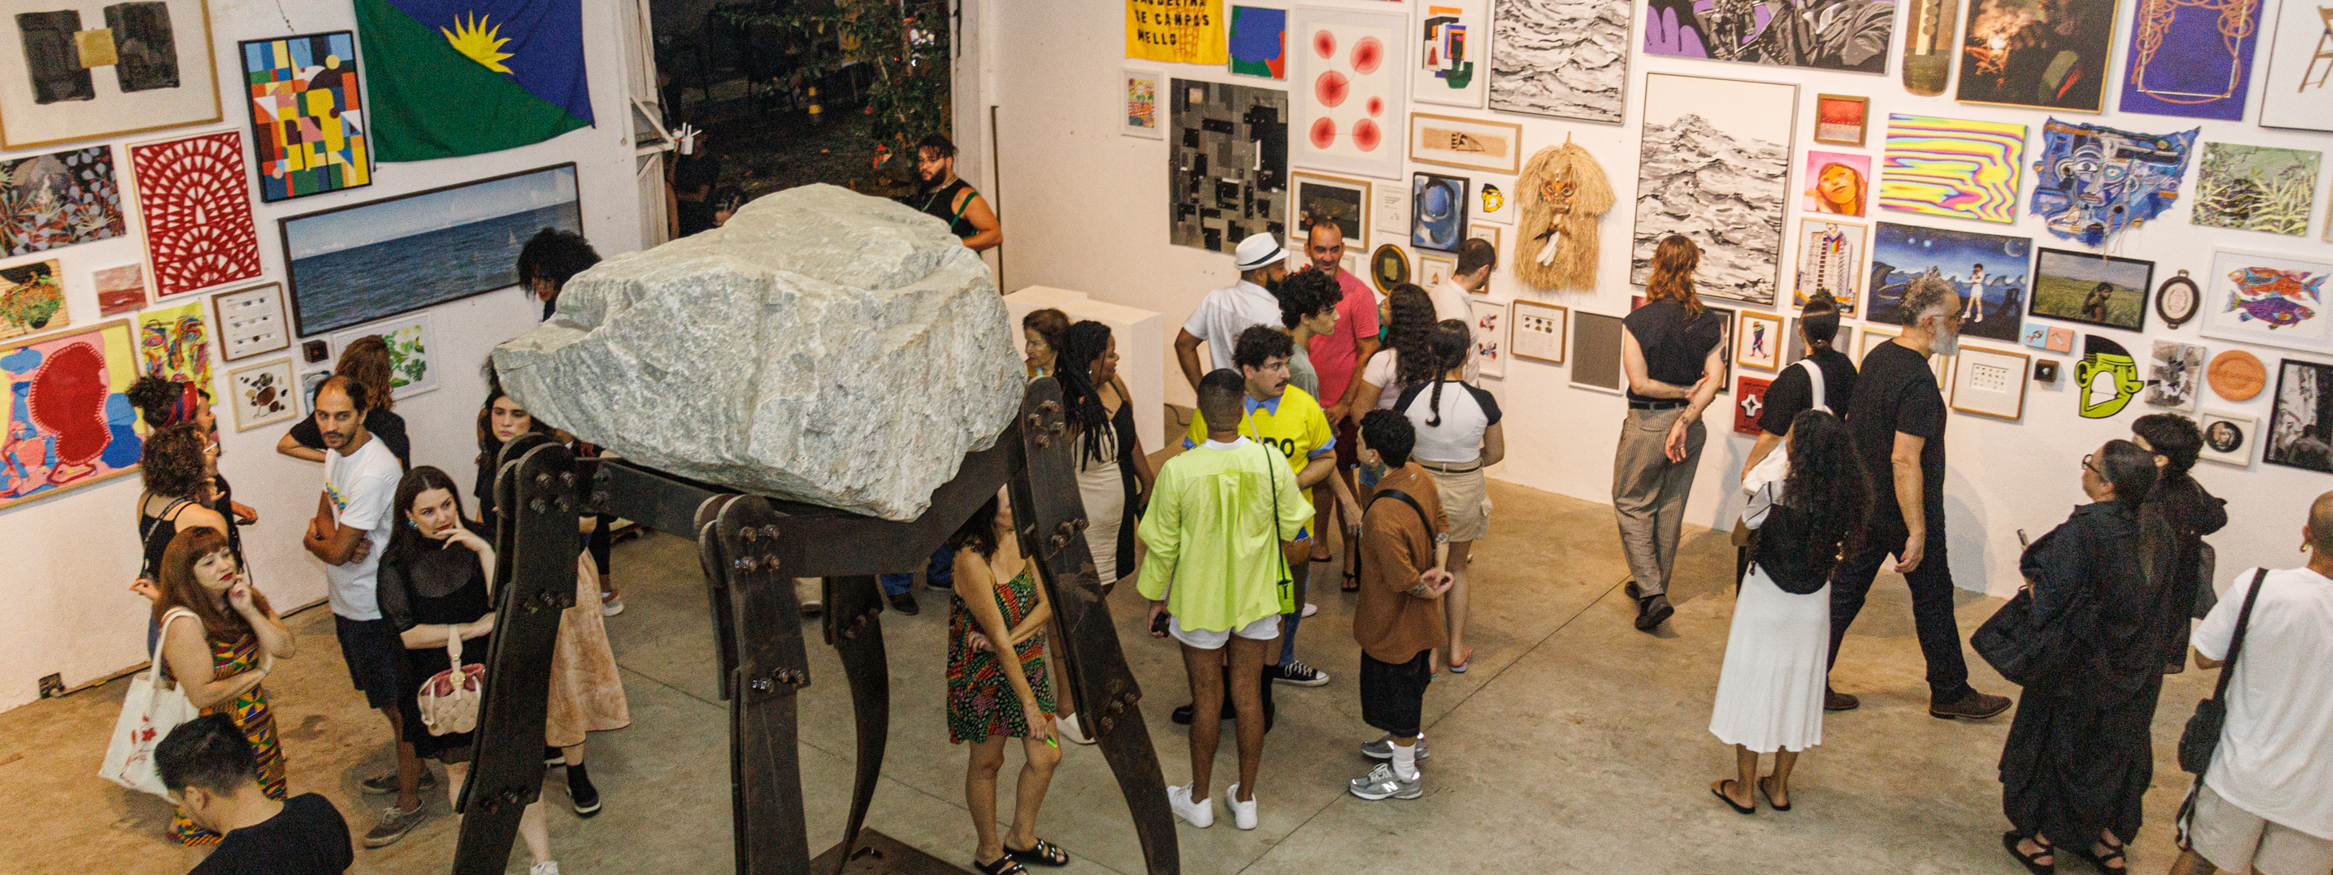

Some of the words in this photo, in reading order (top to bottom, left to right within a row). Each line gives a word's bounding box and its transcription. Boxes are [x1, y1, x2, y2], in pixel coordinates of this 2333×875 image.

[1155, 13, 1209, 26] CAMPOS
[1137, 29, 1176, 45] MELLO
[1382, 781, 1398, 792] N
